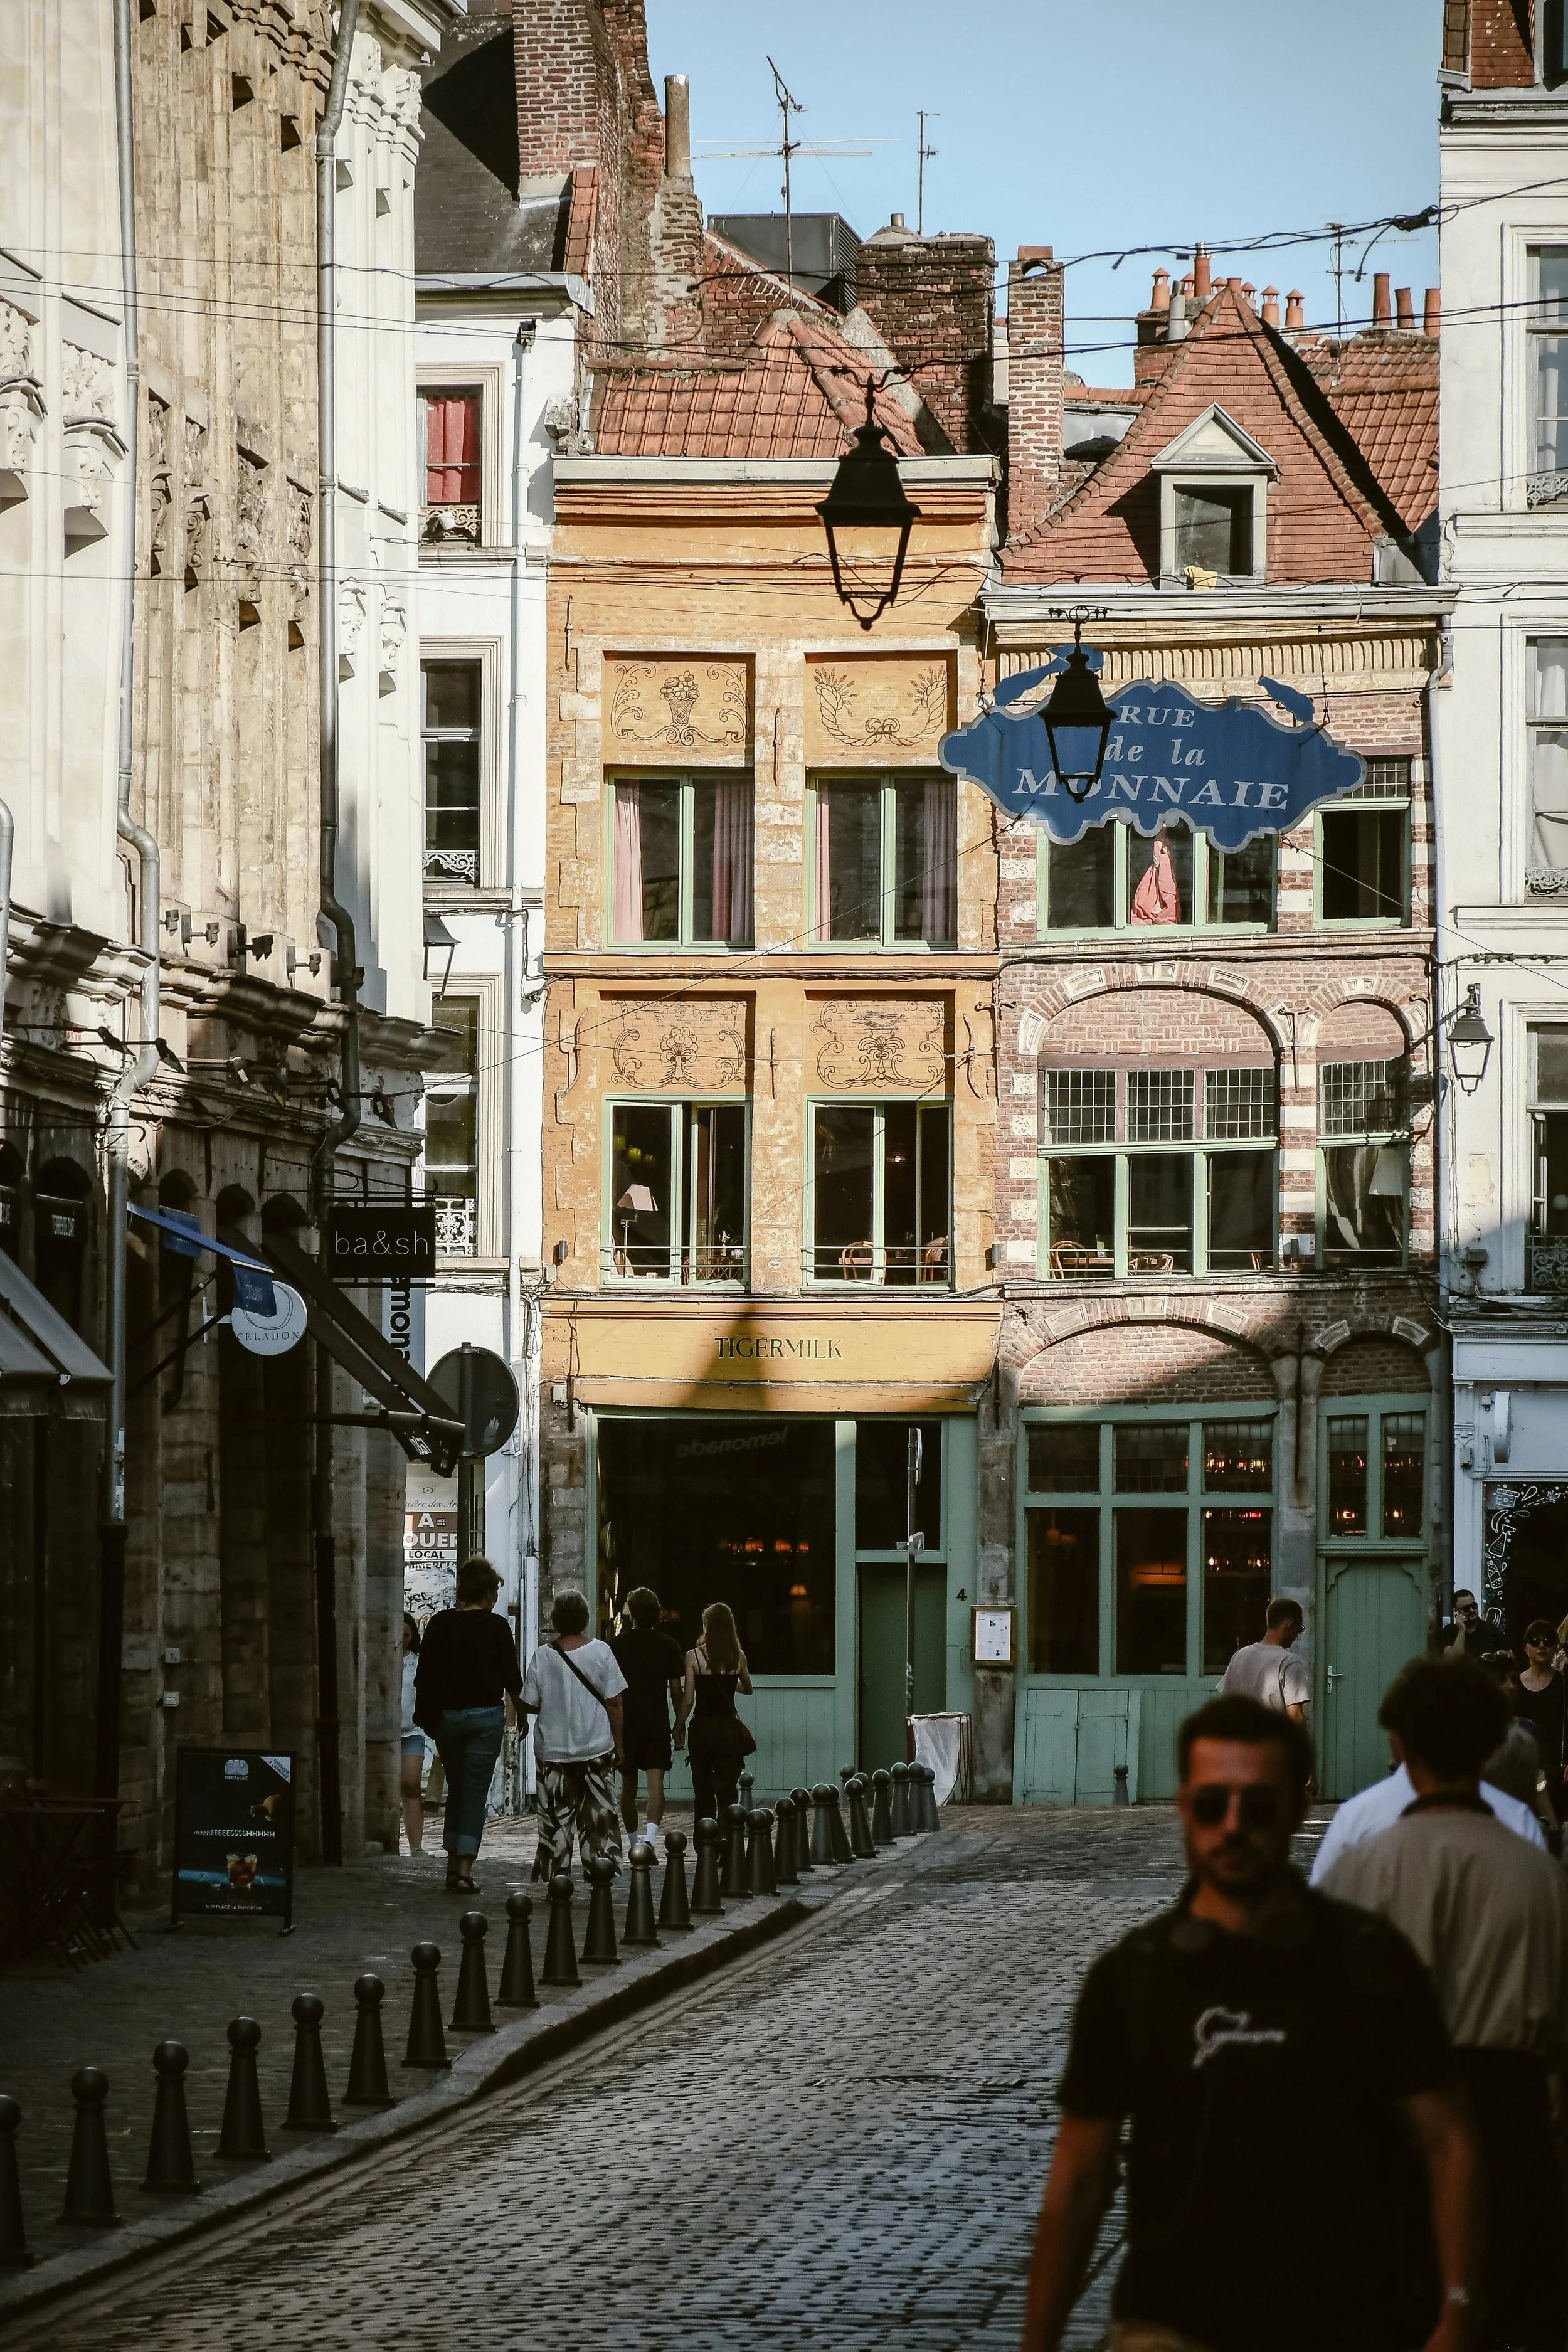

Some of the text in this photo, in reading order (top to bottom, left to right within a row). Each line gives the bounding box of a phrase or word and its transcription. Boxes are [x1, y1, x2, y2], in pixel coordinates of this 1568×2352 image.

[1116, 706, 1195, 728] RUE
[1104, 735, 1206, 766] de la
[335, 1230, 428, 1255] ba&sh
[237, 1331, 300, 1341] CÉLADON
[714, 1337, 844, 1359] TIGERMILK
[428, 1498, 442, 1507] des
[408, 1550, 445, 1559] LOCAL
[956, 1588, 967, 1601] 4
